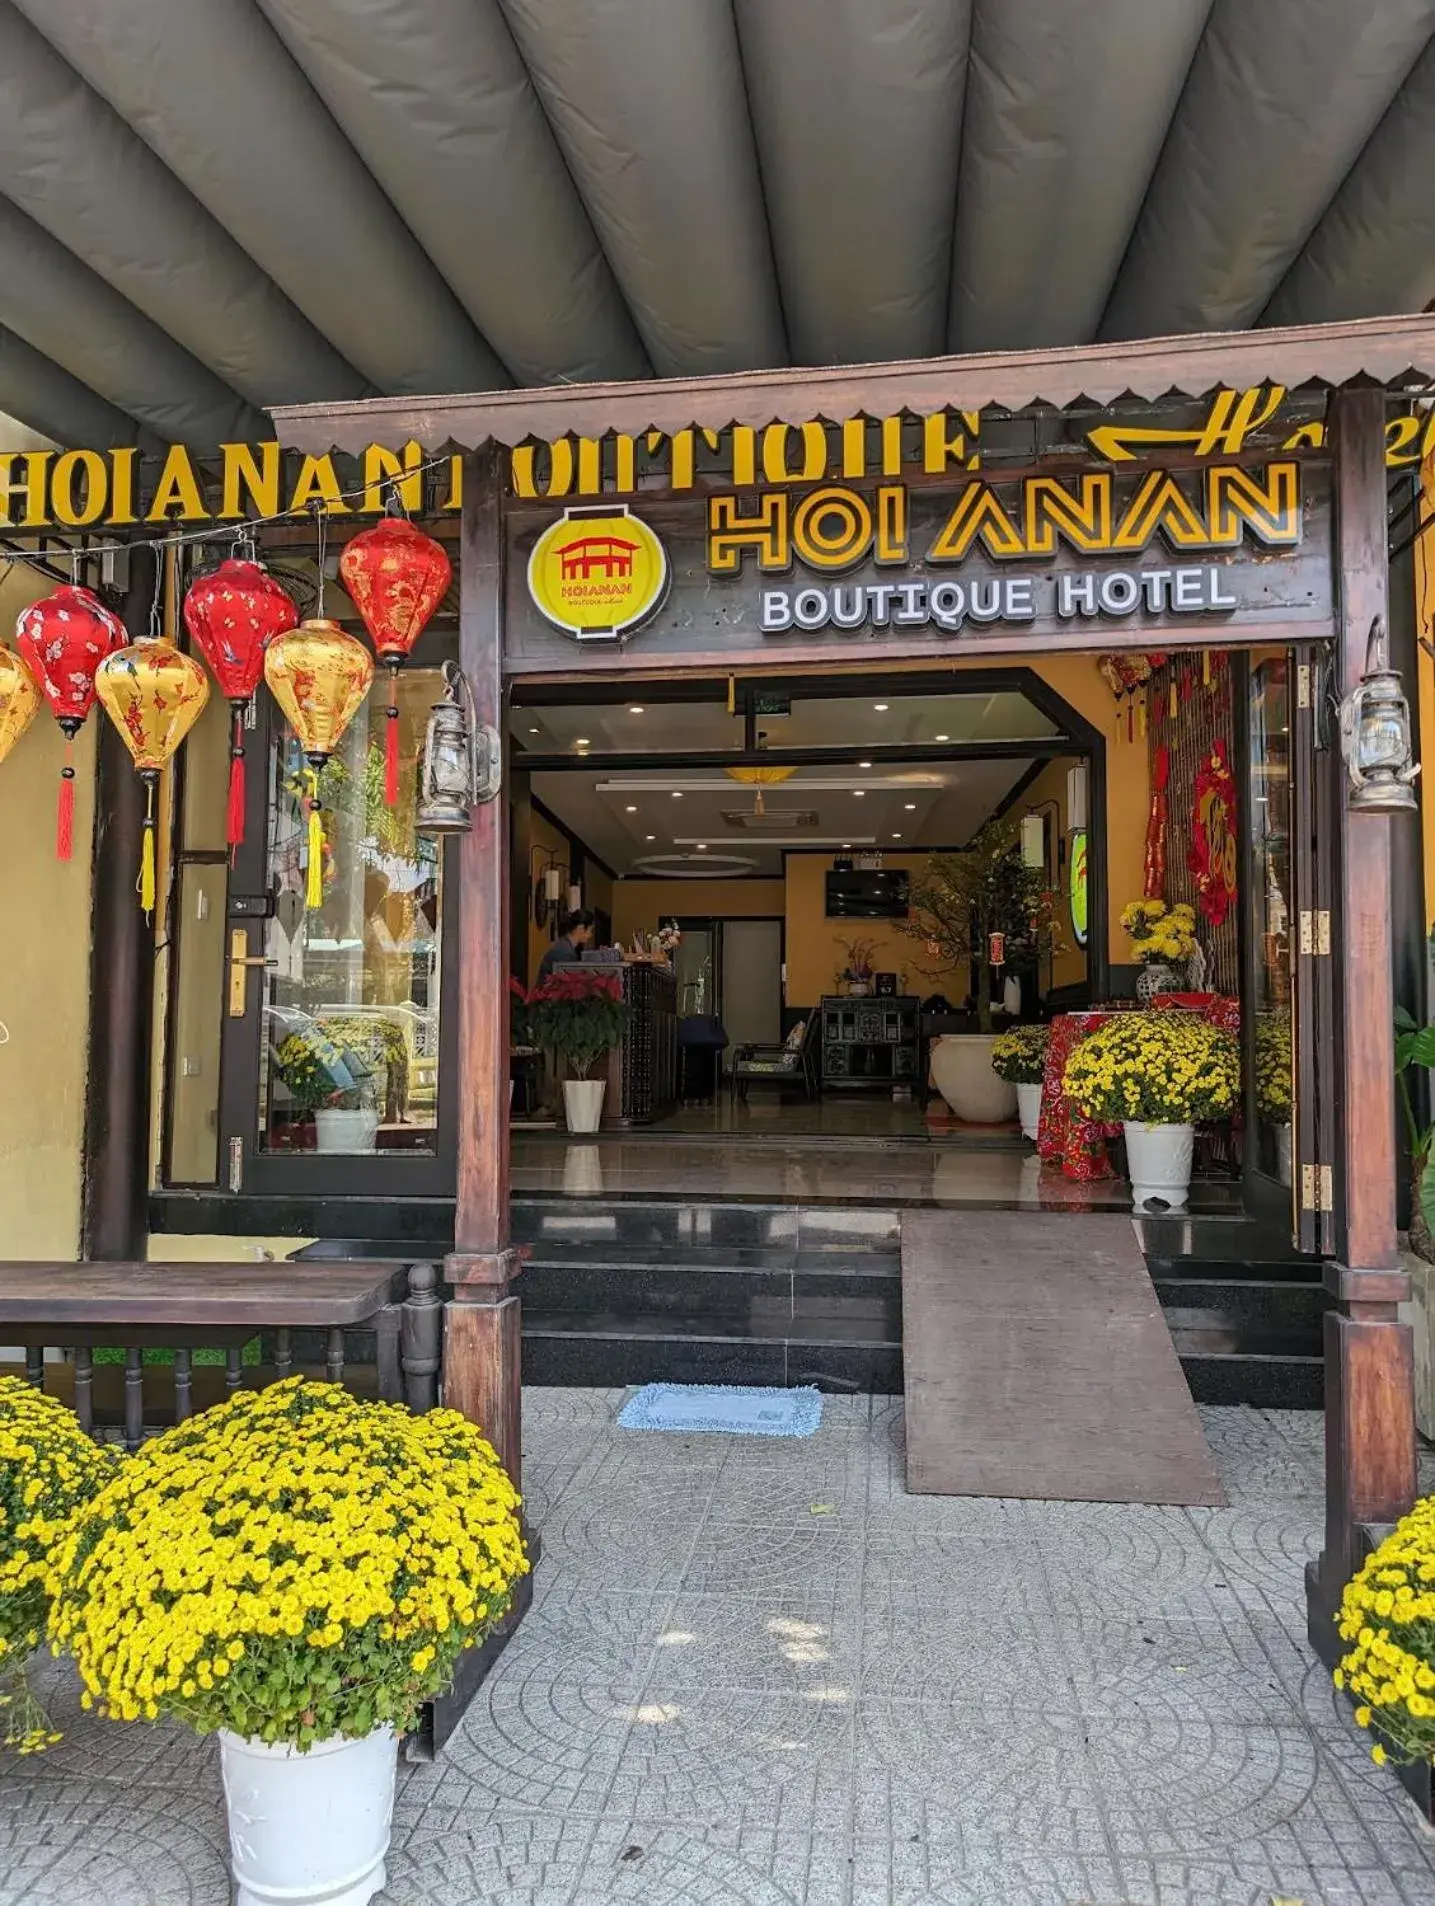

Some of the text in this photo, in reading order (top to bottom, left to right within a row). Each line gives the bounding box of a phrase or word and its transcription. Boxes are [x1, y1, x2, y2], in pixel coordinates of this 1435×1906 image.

[442, 411, 980, 509] OUTIQUE
[709, 462, 1298, 568] HOI ANAN
[763, 567, 1237, 626] BOUTIQUE HOTEL
